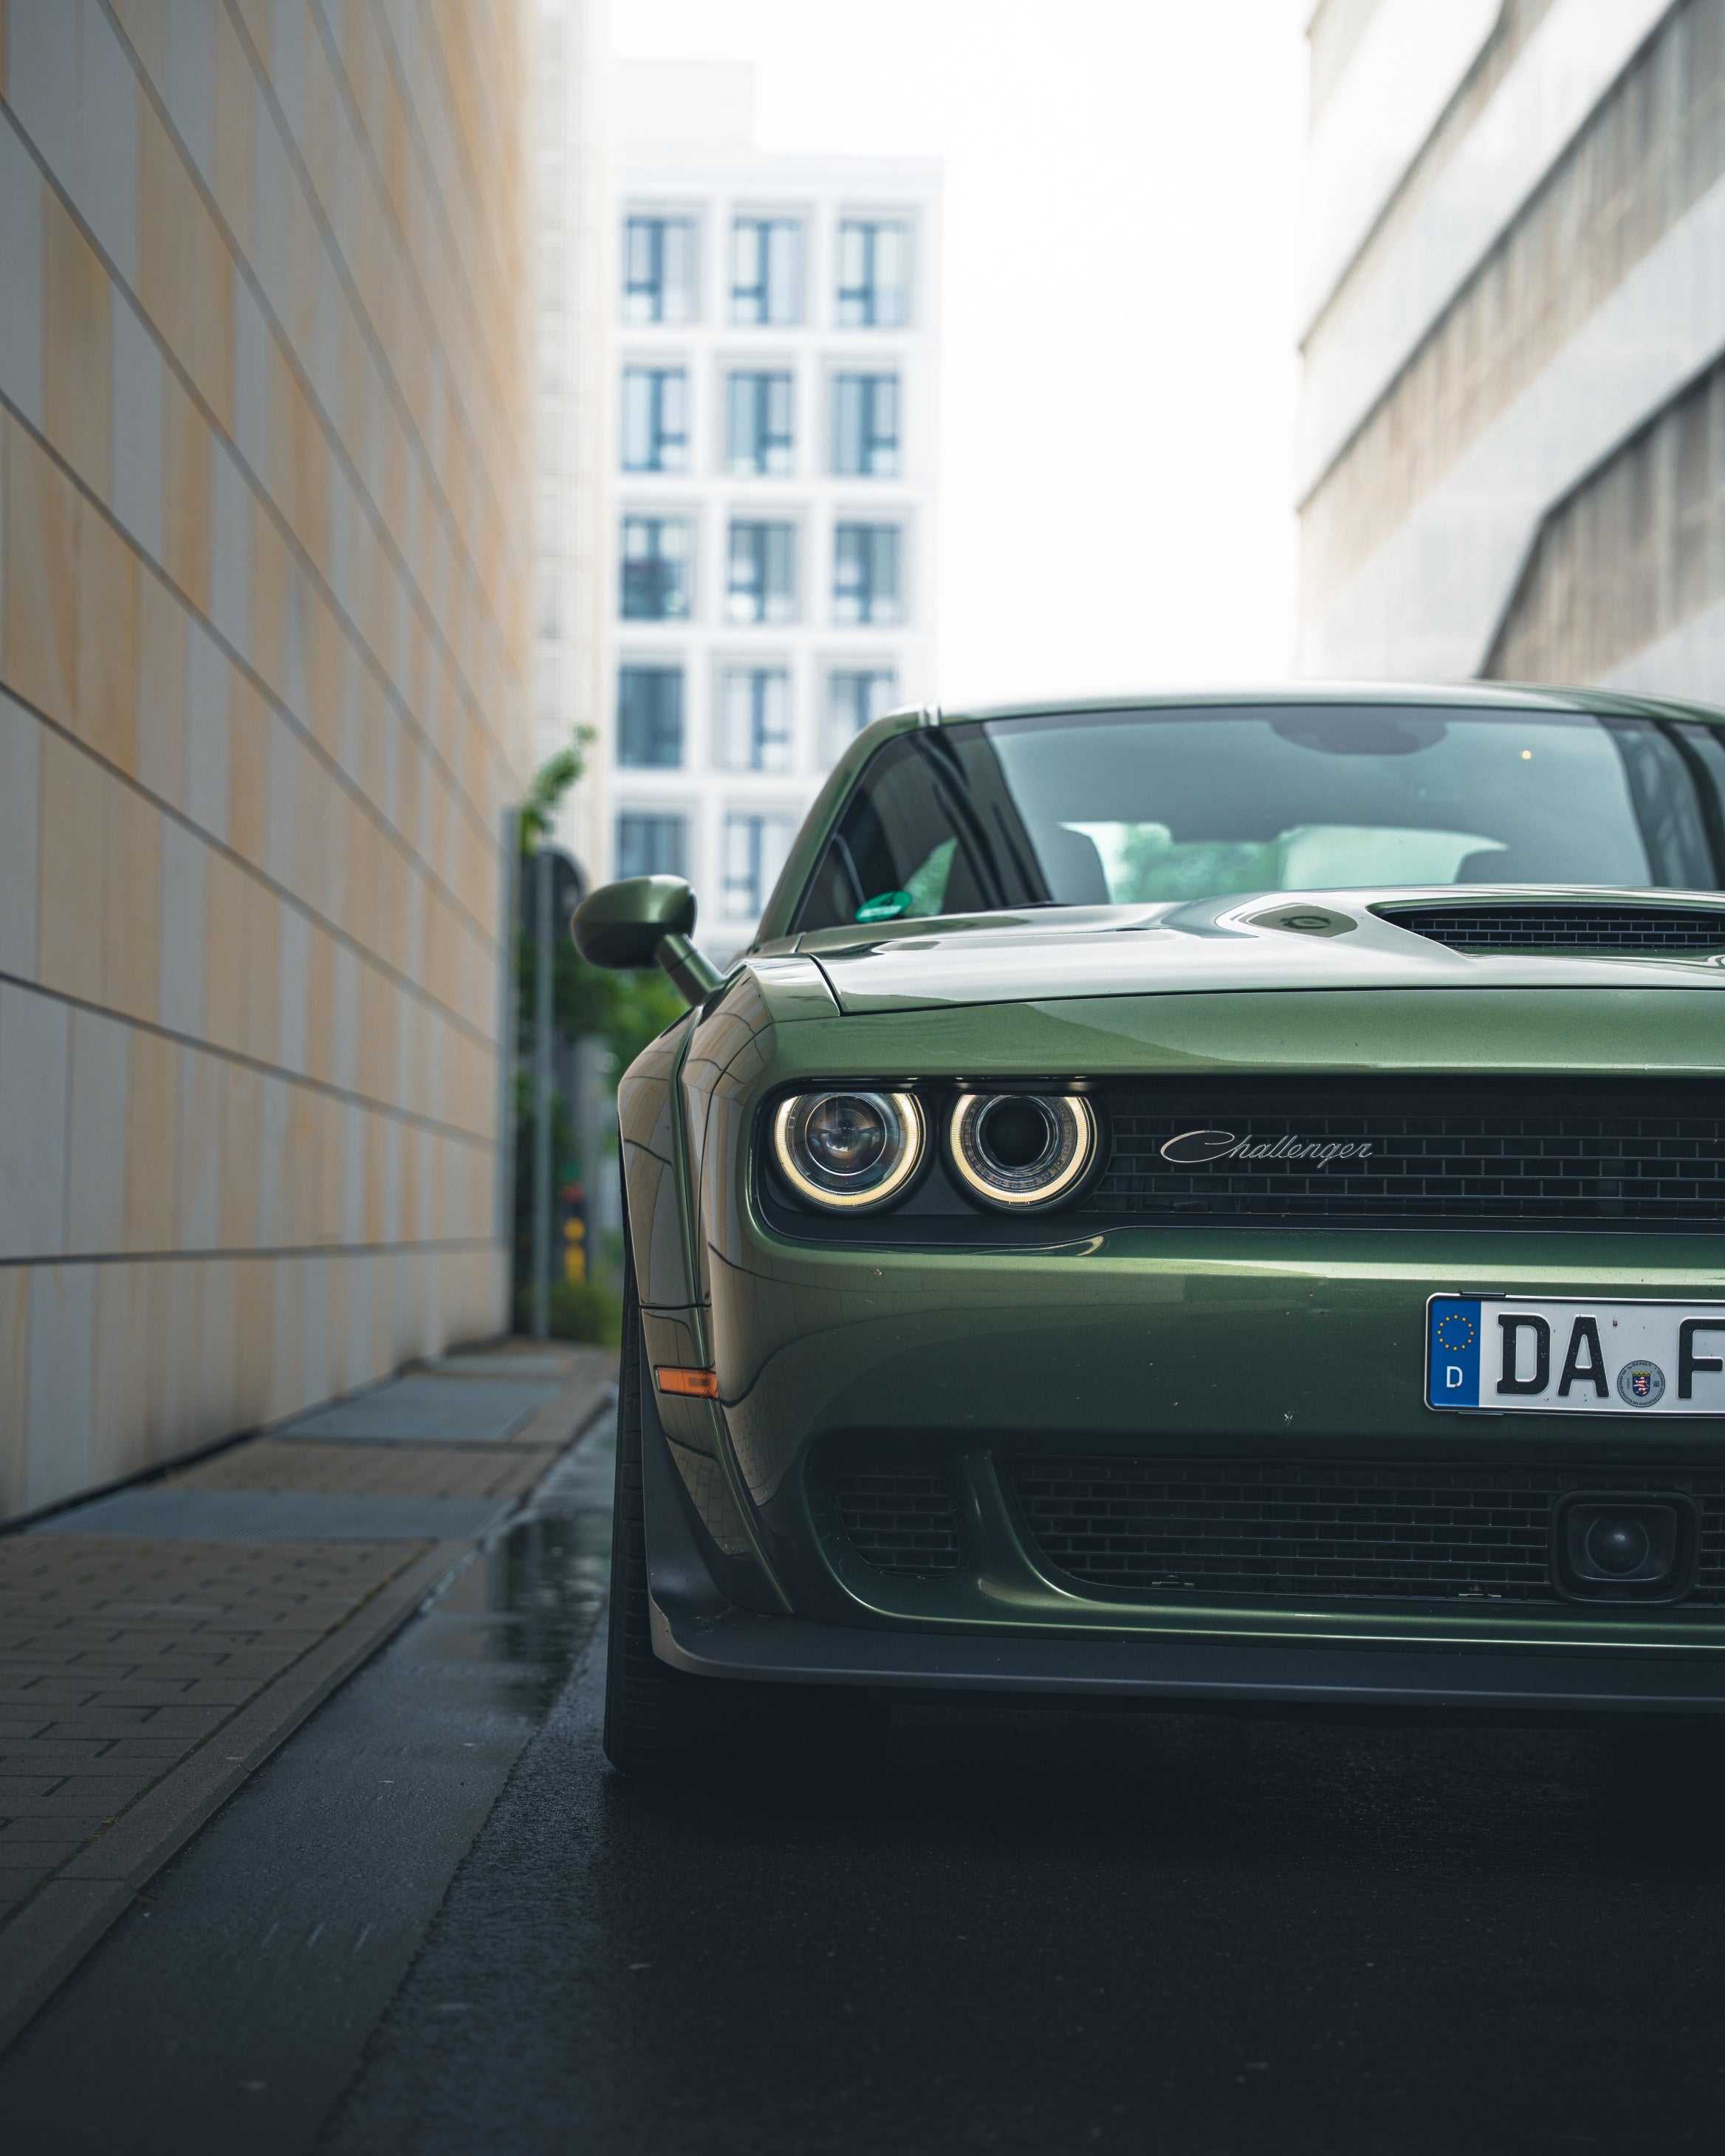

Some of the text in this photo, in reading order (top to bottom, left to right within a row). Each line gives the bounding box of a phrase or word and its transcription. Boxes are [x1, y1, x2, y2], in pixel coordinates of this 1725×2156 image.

[1160, 1130, 1374, 1169] Challenger
[1497, 1314, 1610, 1398] DA
[1677, 1317, 1725, 1399] F
[1446, 1365, 1463, 1388] D
